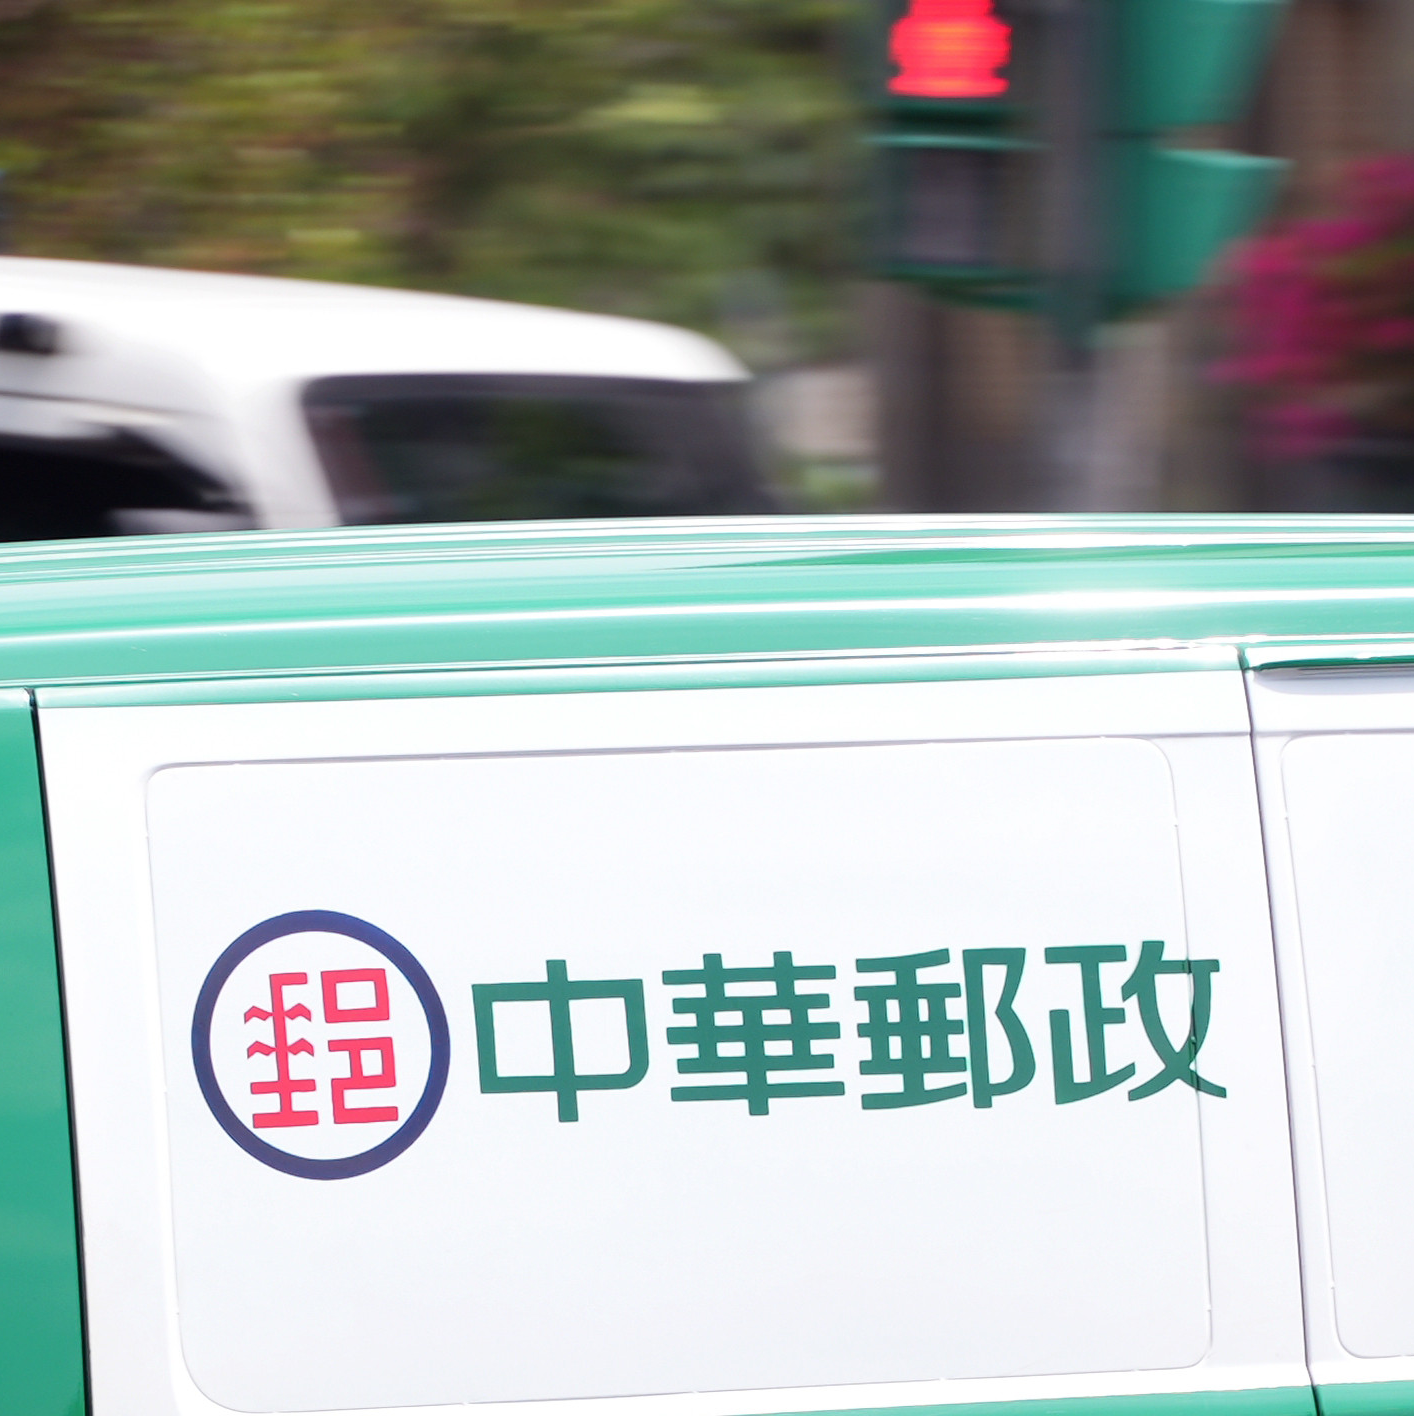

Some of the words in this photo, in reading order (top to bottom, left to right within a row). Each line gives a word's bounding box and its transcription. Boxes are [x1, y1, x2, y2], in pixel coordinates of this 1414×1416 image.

[245, 967, 399, 1129] 郵
[471, 939, 1228, 1122] 中華郵政
